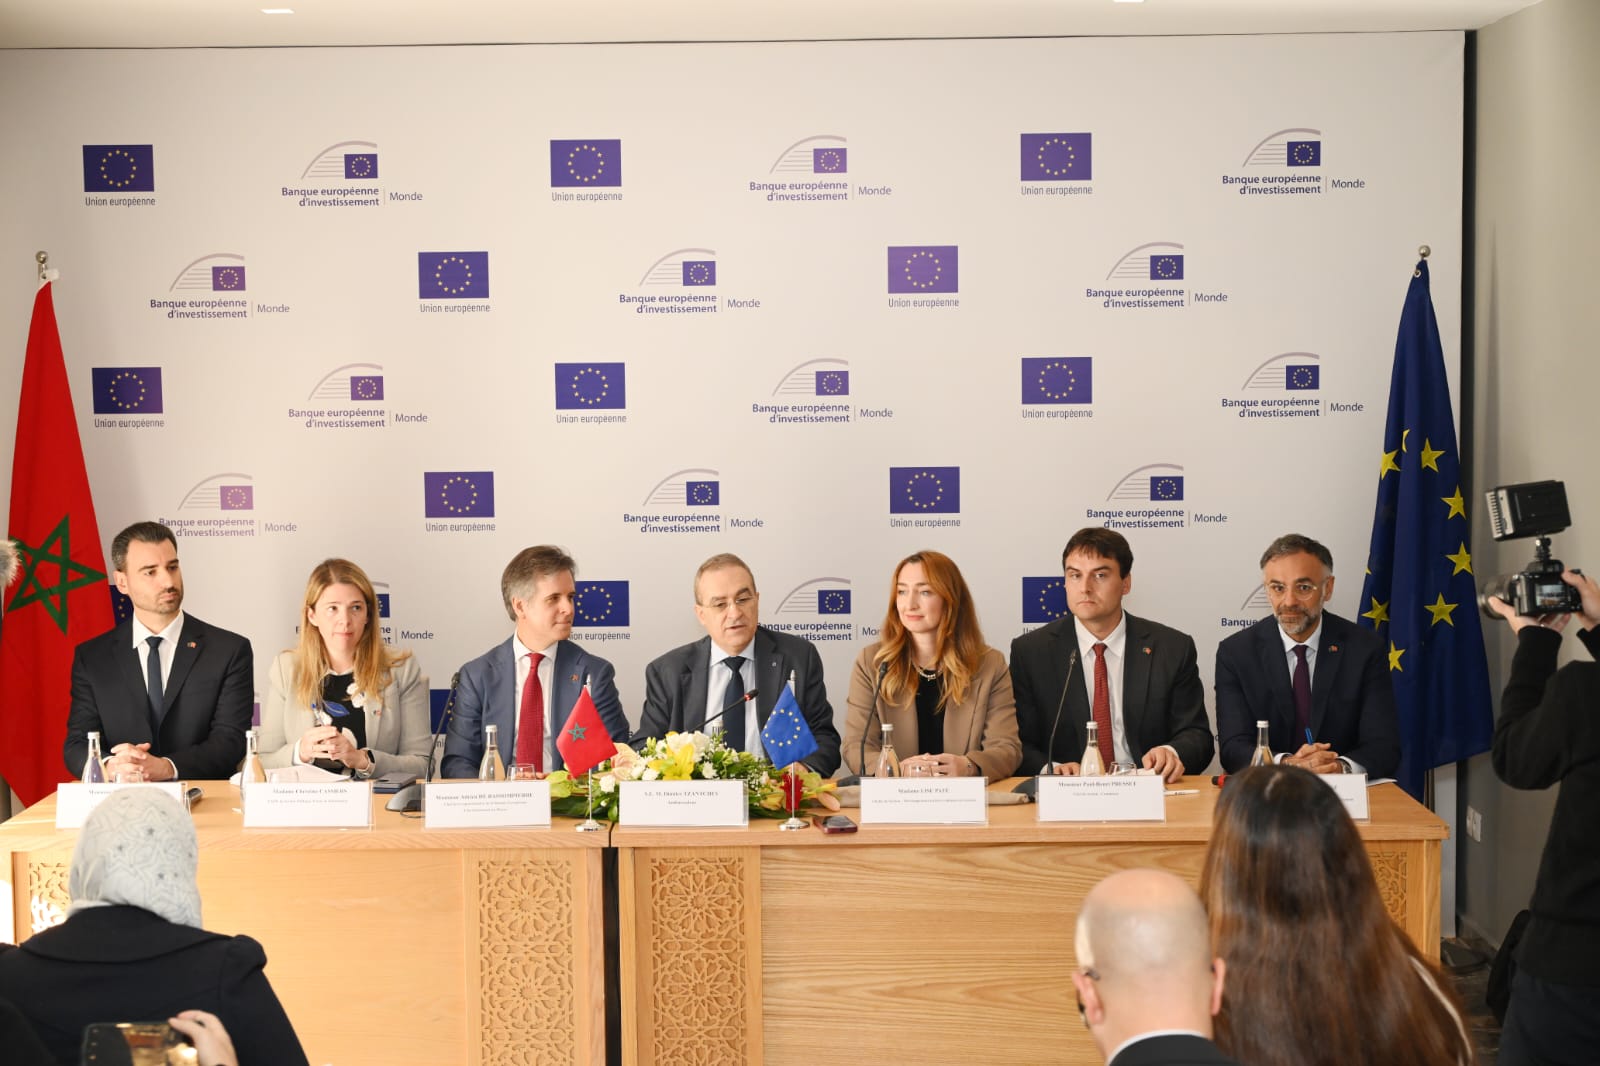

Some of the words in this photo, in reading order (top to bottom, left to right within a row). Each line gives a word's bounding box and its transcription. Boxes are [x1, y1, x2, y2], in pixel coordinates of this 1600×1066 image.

[1222, 175, 1260, 186] Banque
[1261, 174, 1321, 185] européenne
[1331, 179, 1365, 188] Monde
[749, 181, 786, 192] Banque
[789, 180, 848, 191] européenne
[858, 187, 892, 195] Monde
[281, 187, 318, 198] Banque
[320, 187, 379, 198] européenne
[389, 192, 423, 201] Monde
[1021, 186, 1044, 195] Union
[1045, 186, 1093, 197] européenne
[85, 197, 108, 206] Union
[109, 197, 156, 207] européenne
[551, 192, 574, 201] Union
[576, 192, 623, 203] européenne
[1086, 288, 1123, 299] Banque
[1125, 287, 1185, 298] européenne
[1194, 293, 1228, 302] Monde
[619, 294, 656, 304] Banque
[658, 293, 717, 304] européenne
[727, 299, 761, 308] Monde
[888, 298, 911, 307] Union
[913, 298, 959, 309] européenne
[150, 299, 187, 310] Banque
[189, 298, 247, 309] européenne
[257, 304, 290, 313] Monde
[420, 304, 443, 313] Union
[444, 304, 491, 315] européenne
[1222, 398, 1259, 408] Banque
[1261, 397, 1320, 408] européenne
[1330, 402, 1364, 412] Monde
[288, 408, 325, 419] Banque
[327, 408, 385, 418] européenne
[752, 404, 789, 414] Banque
[791, 403, 850, 413] européenne
[860, 409, 893, 417] Monde
[1022, 409, 1045, 418] Union
[1046, 408, 1093, 419] européenne
[395, 413, 428, 422] Monde
[556, 414, 579, 423] Union
[580, 414, 627, 424] européenne
[94, 419, 117, 428] Union
[118, 419, 165, 429] européenne
[623, 513, 660, 524] Banque
[662, 512, 720, 523] européenne
[1087, 509, 1124, 519] Banque
[1126, 508, 1184, 519] européenne
[1194, 513, 1228, 522] Monde
[197, 517, 255, 528] européenne
[264, 523, 297, 531] Monde
[730, 518, 764, 527] Monde
[890, 518, 913, 527] Union
[914, 518, 961, 528] européenne
[425, 523, 448, 532] Union
[449, 523, 496, 533] européenne
[794, 621, 852, 632] européenne
[401, 630, 434, 640] Monde
[570, 632, 583, 640] ion
[584, 632, 631, 642] européenne
